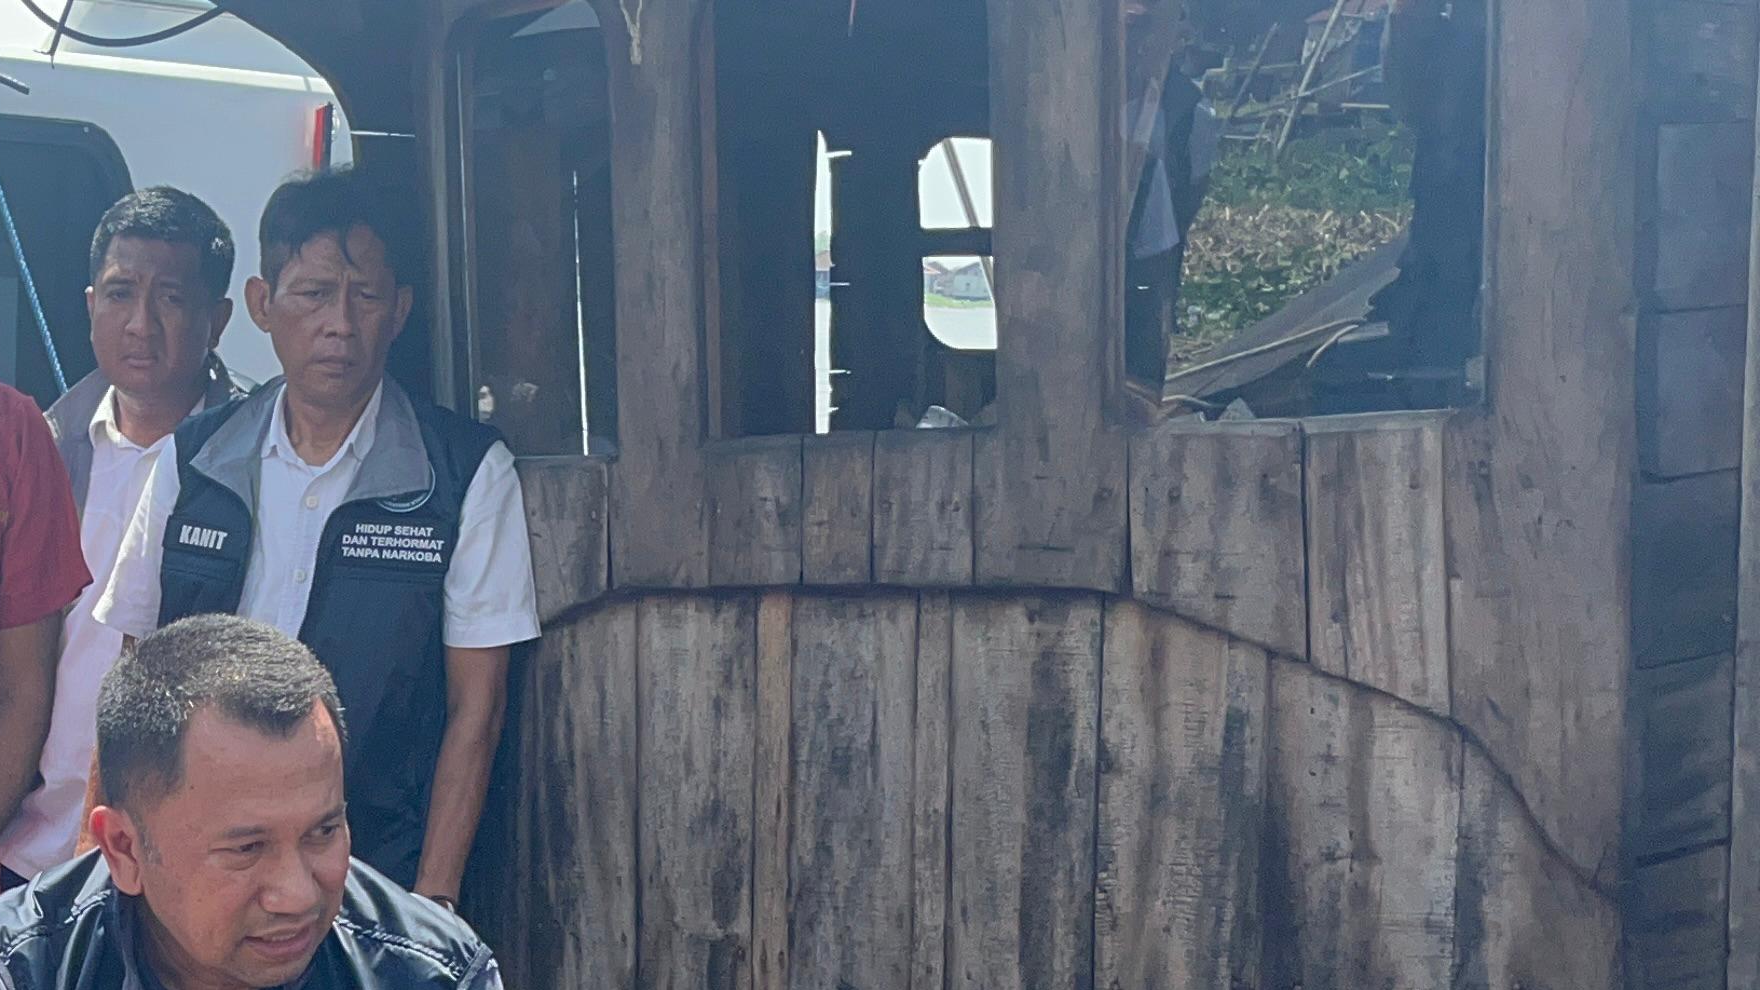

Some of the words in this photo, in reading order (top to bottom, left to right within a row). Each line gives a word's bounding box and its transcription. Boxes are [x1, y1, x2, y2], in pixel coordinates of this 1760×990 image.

[179, 524, 228, 550] KANIT
[355, 523, 392, 534] HIDUP
[394, 525, 434, 537] SEHAT
[342, 534, 368, 545] DAN
[370, 536, 445, 550] TERHORMAT
[341, 547, 380, 558] TANPA
[381, 549, 442, 562] NARKOBA
